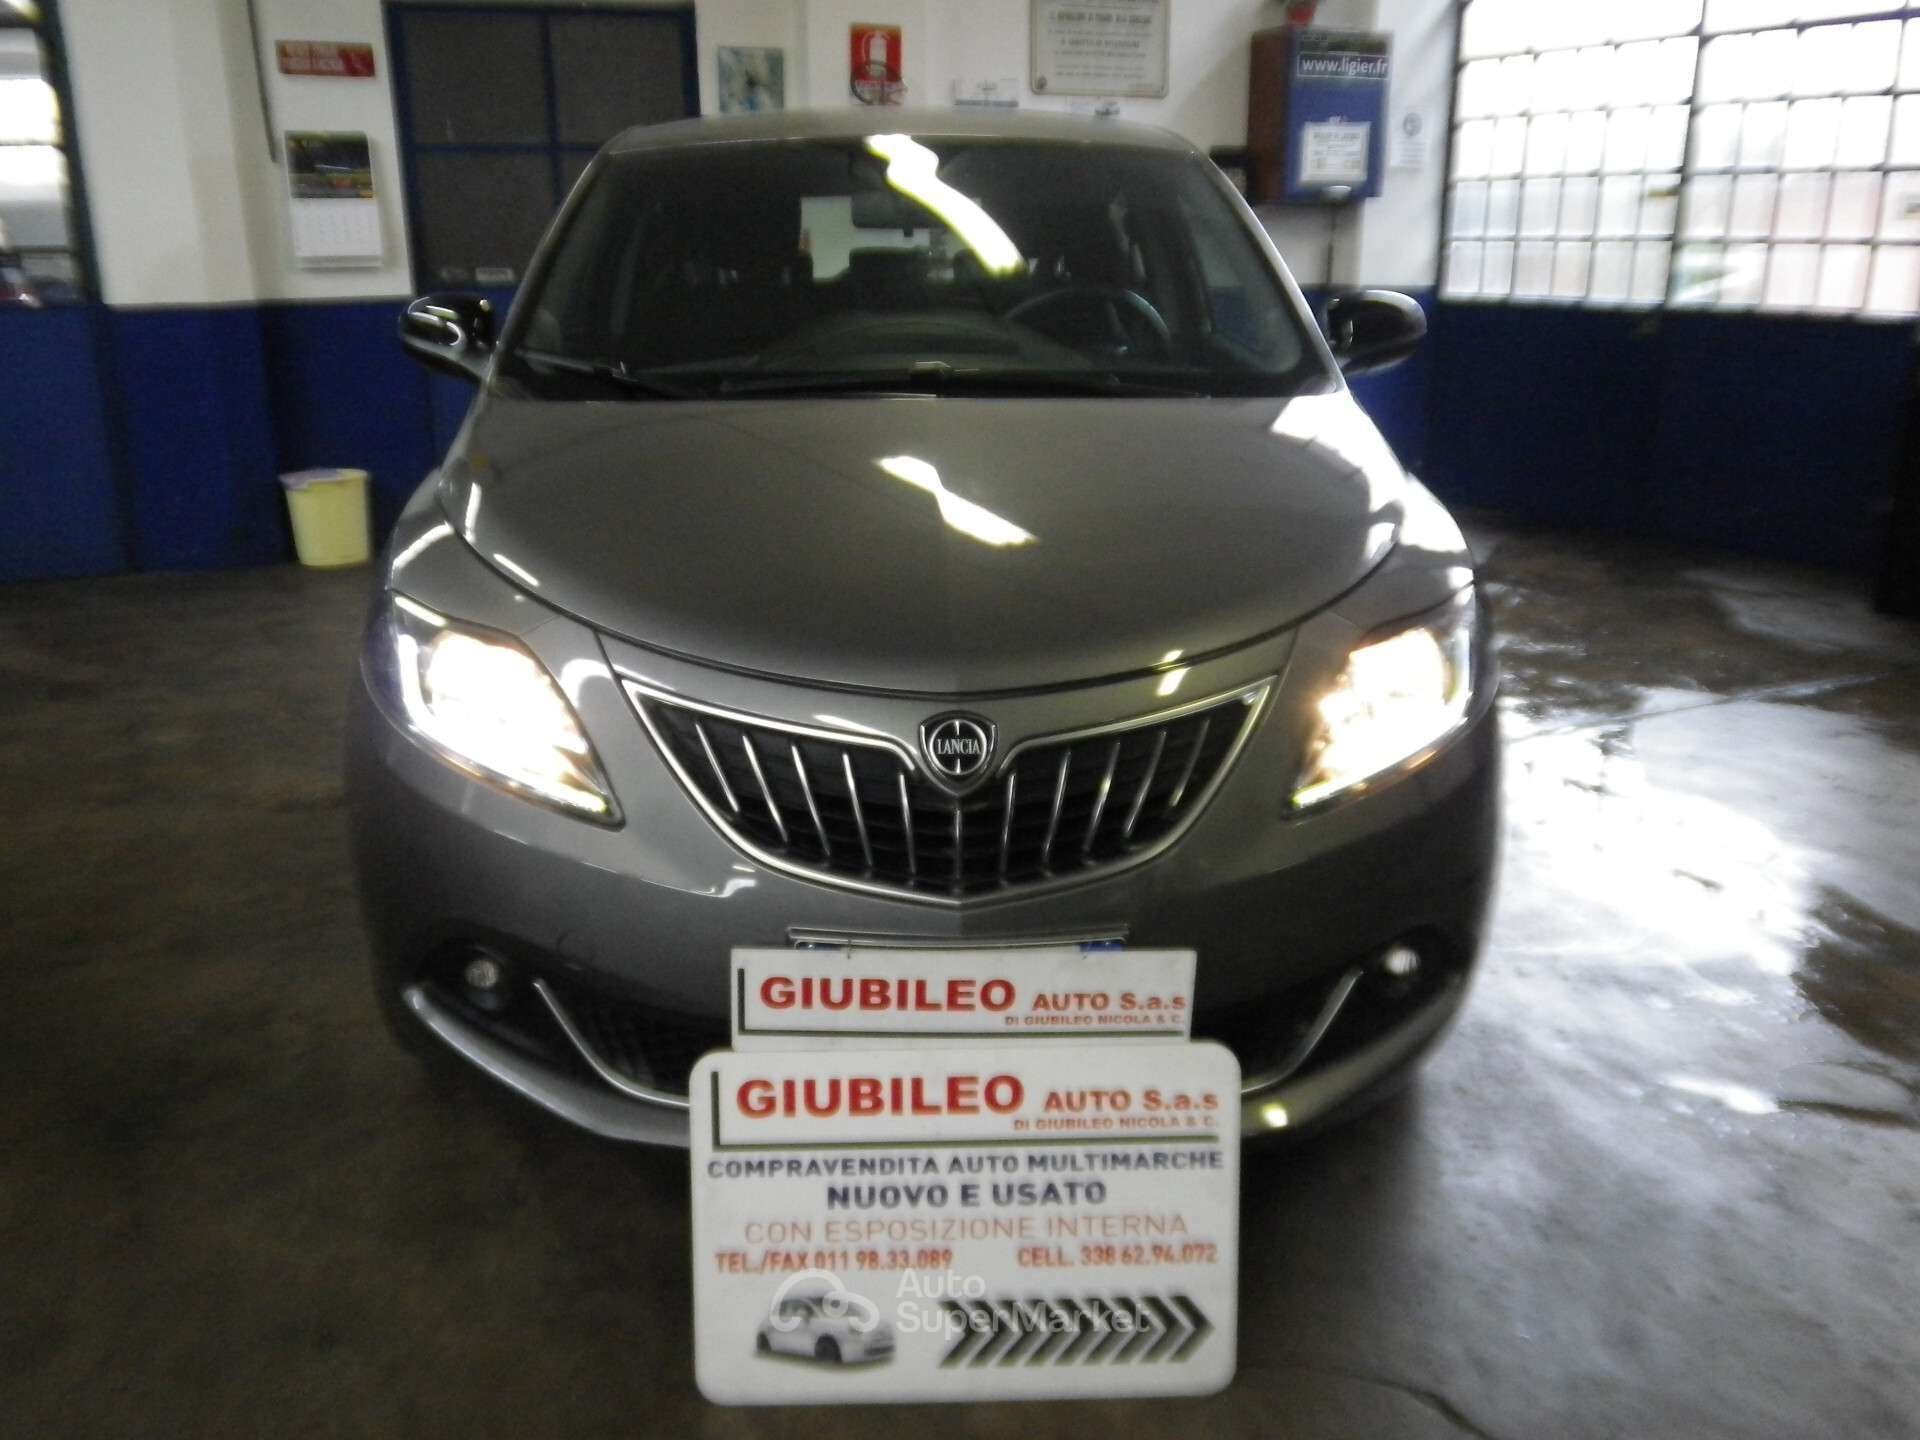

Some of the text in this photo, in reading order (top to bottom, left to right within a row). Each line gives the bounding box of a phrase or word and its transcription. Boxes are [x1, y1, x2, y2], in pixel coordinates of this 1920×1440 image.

[1301, 56, 1388, 76] www.ligier.fr
[937, 738, 981, 755] LANCIA
[760, 977, 1186, 1011] GIUBILEO AUTO S.a.s
[1005, 1016, 1019, 1026] DI
[1024, 1015, 1093, 1026] GIUBILEO
[1097, 1014, 1151, 1025] NICOLA
[737, 1076, 1218, 1119] GIUBILEO AUTO S.a.s
[1014, 1119, 1029, 1131] DI
[1035, 1117, 1114, 1131] GIUBILEO
[1119, 1115, 1180, 1129] NICOLA
[707, 1150, 1224, 1179] COMPRAVENDITA AUTO MULTIMARCHE
[827, 1181, 1107, 1210] NUOVO E USATO
[745, 1213, 1189, 1244] CON ESPOSIZIONE INTERNA
[715, 1252, 808, 1274] TEL./FAX
[814, 1252, 849, 1271] 011
[855, 1249, 953, 1271] 98.33.089
[1017, 1248, 1074, 1268] CELL.
[1081, 1246, 1117, 1266] 338
